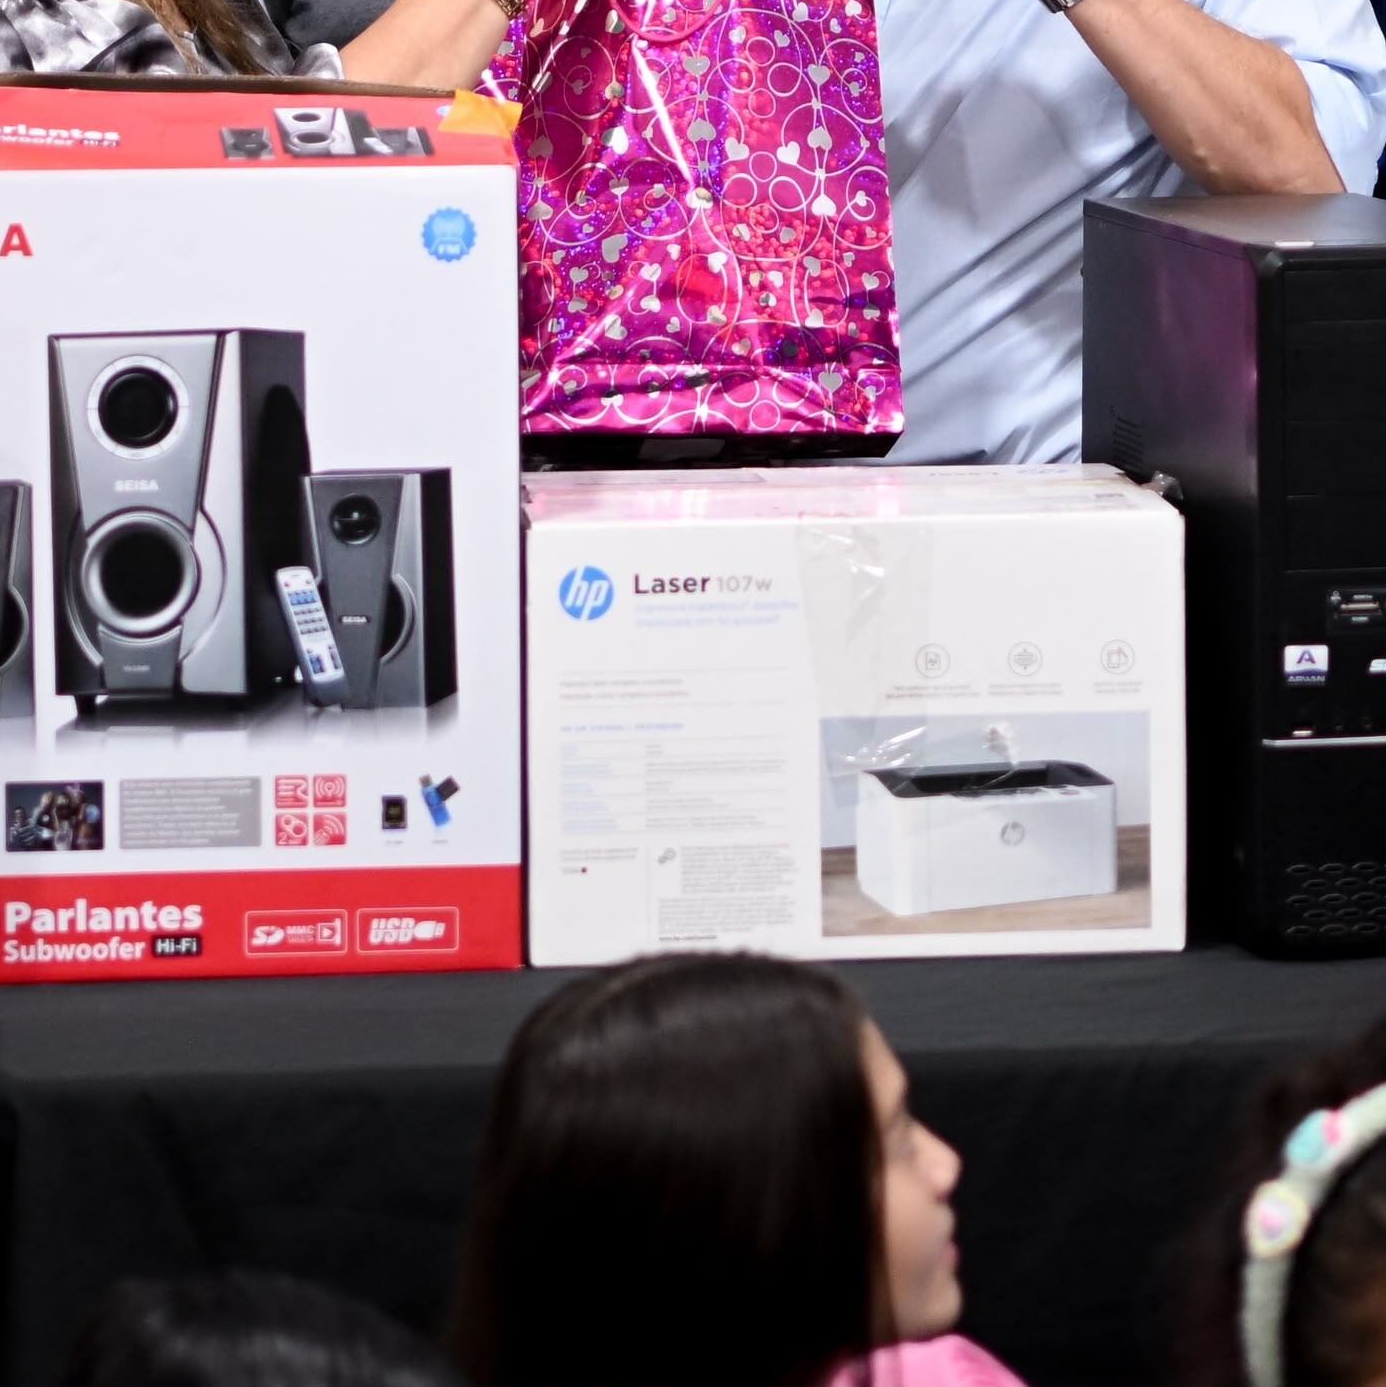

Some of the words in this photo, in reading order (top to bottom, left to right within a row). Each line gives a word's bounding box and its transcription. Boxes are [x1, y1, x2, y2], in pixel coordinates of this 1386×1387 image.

[114, 478, 159, 493] SEISA
[562, 566, 611, 620] hp
[633, 573, 711, 595] Laser
[717, 575, 773, 593] 107w
[4, 898, 203, 934] Parlantes
[4, 937, 146, 963] Subwoofer
[155, 937, 199, 955] Hi-Fi
